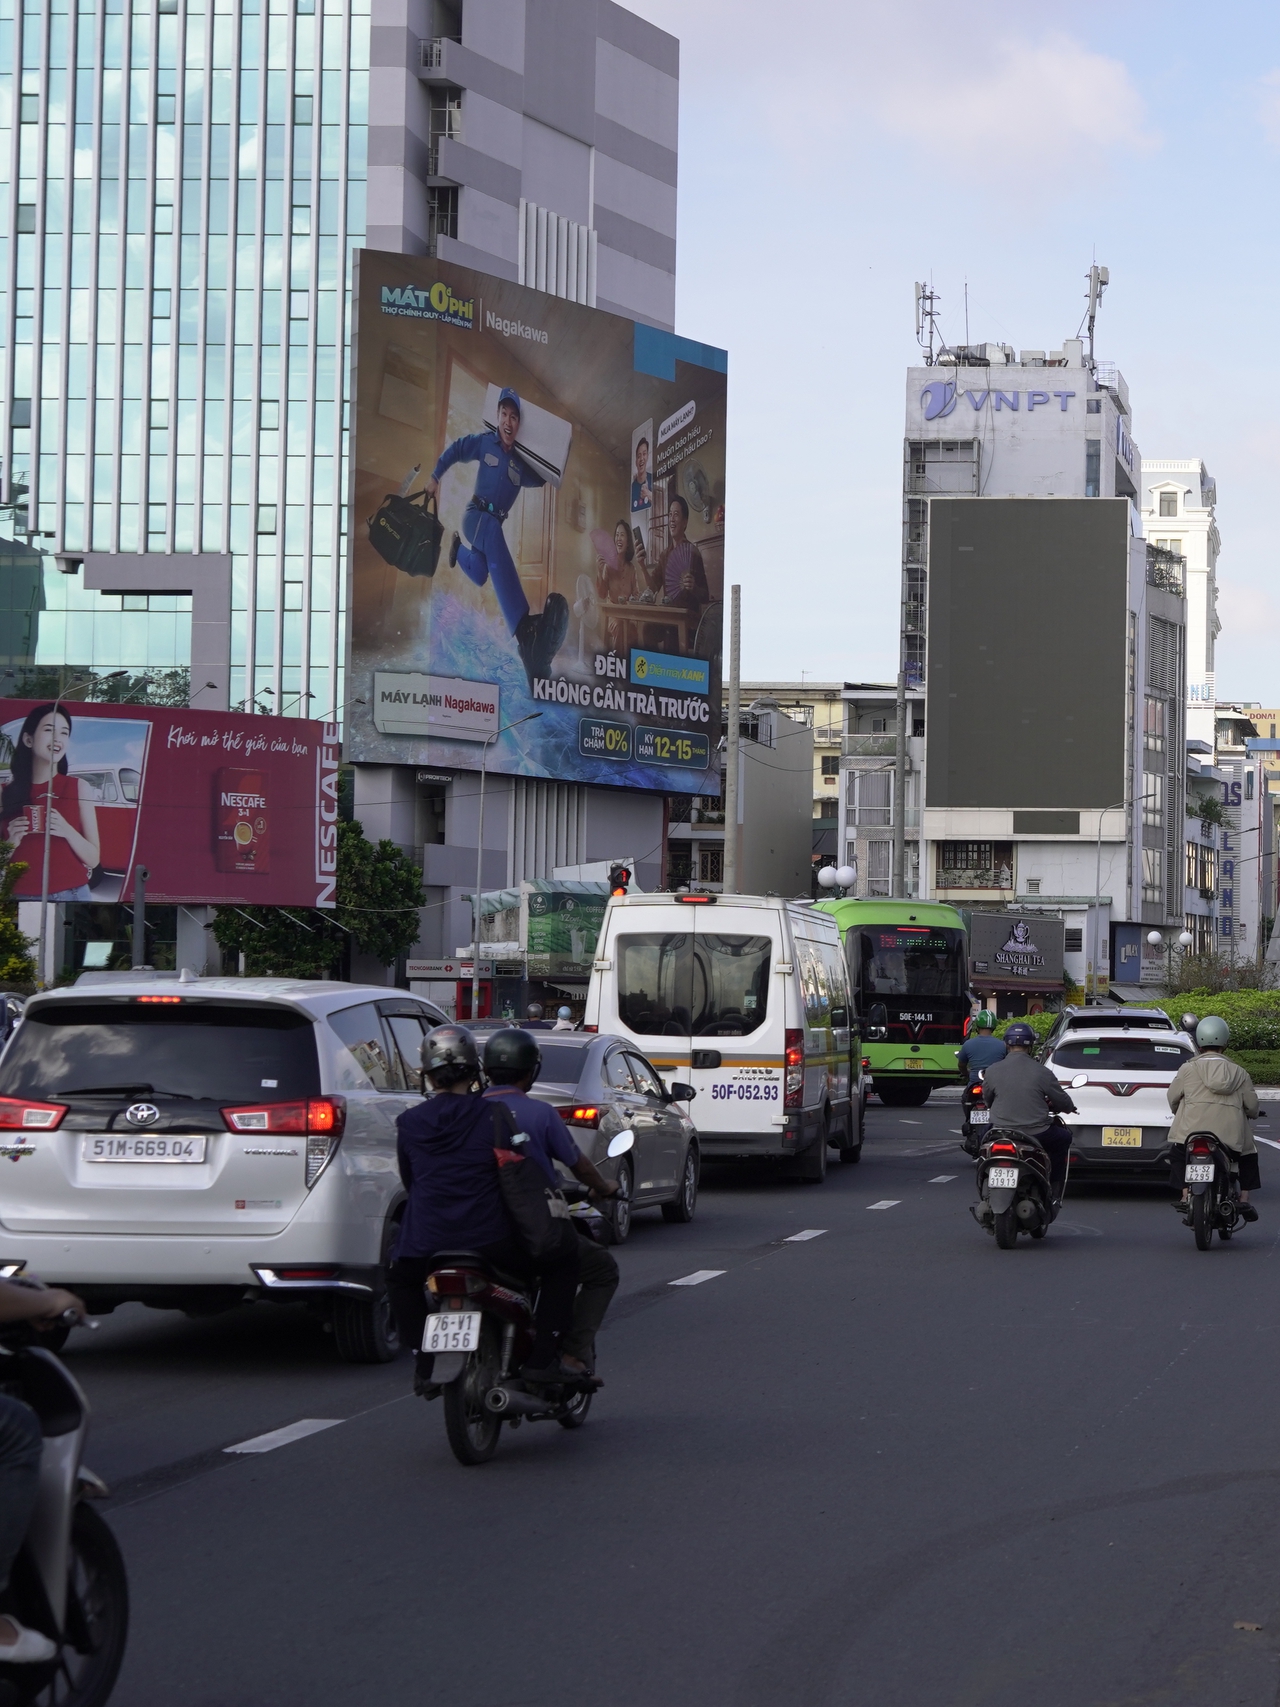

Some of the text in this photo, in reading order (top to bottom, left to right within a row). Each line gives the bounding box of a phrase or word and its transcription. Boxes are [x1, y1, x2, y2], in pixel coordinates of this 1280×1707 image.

[382, 285, 474, 319] MÁT PHÍ
[381, 306, 439, 320] THỢ CHÍNH QUY
[486, 310, 548, 344] Nagakawa
[965, 390, 1076, 411] VNPT
[595, 650, 627, 679] ĐẾN
[381, 690, 495, 714] MÁY LẠNH Nagakawa
[533, 677, 709, 723] KHÔNG CẦN TRẢ TRƯỚC
[167, 724, 308, 757] Khơi mở thế giới của bạn
[583, 738, 605, 751] CHẬM
[591, 725, 628, 752] TRẢ 0%
[639, 745, 654, 757] HẠN
[654, 736, 692, 760] 12-15
[995, 952, 1045, 966] SHANGHAI TEA
[900, 1012, 933, 1021] 50E-144.11
[740, 1067, 773, 1075] IVECO
[1114, 1128, 1131, 1136] 60H
[92, 1140, 195, 1157] 51M-669.04
[1107, 1137, 1137, 1146] 344.41
[994, 1169, 1015, 1178] 59-Y3
[990, 1178, 1016, 1187] 319.13
[434, 1314, 472, 1331] 76-V1
[431, 1333, 471, 1348] 8156
